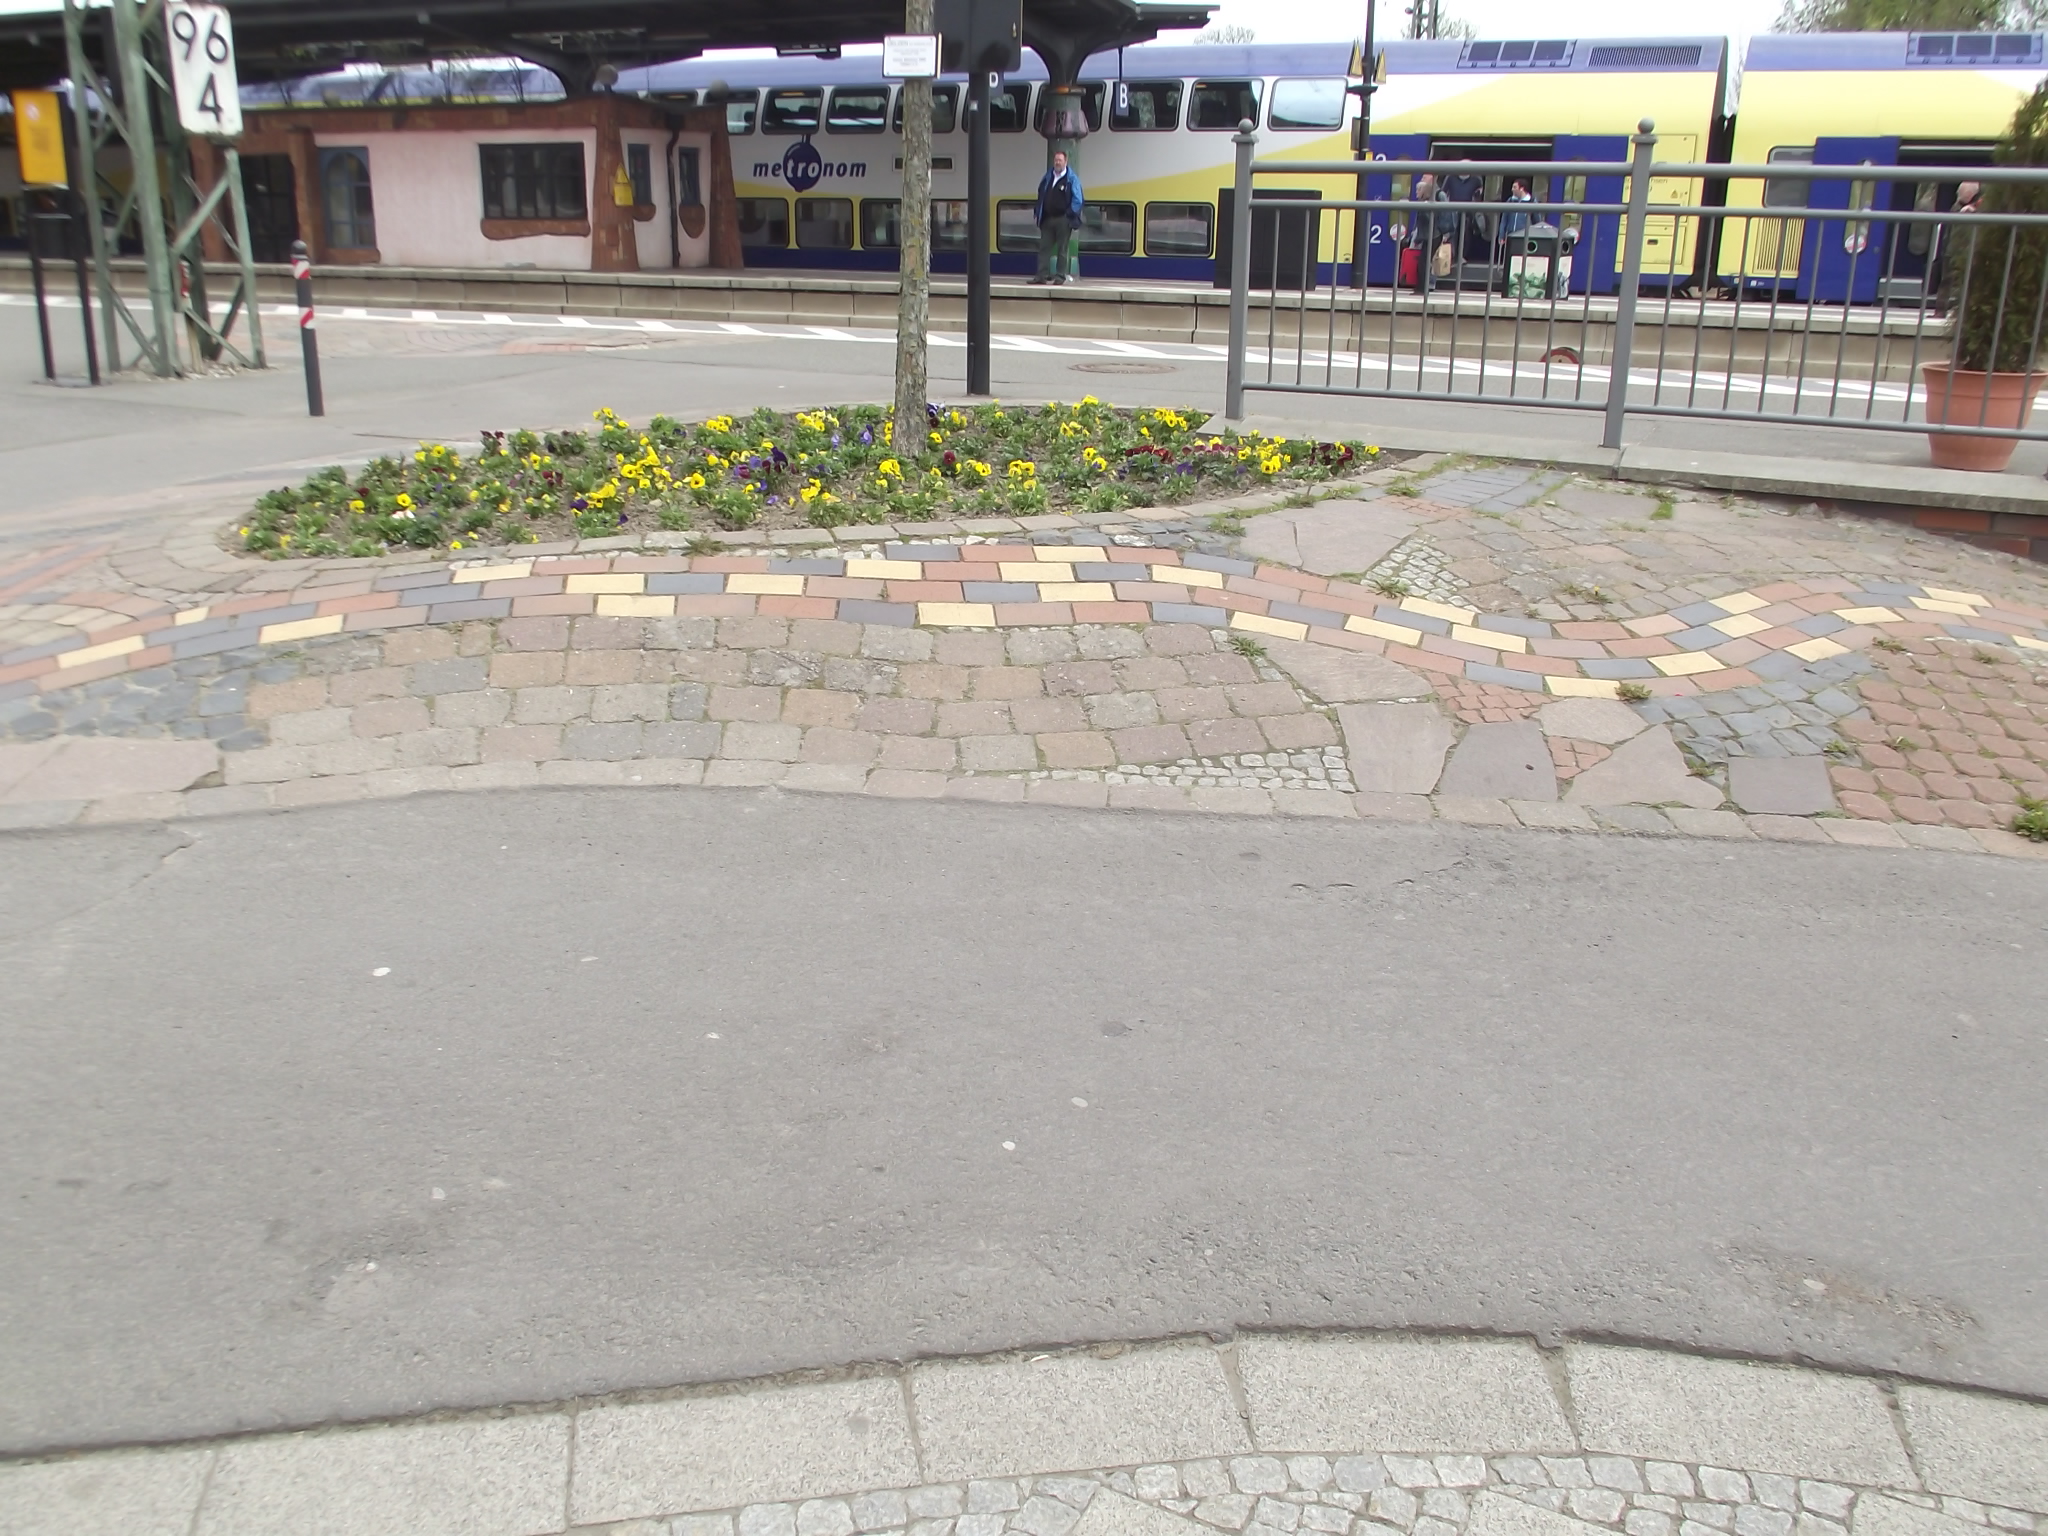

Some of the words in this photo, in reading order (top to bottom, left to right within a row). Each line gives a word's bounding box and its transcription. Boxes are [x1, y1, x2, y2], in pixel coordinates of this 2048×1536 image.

[172, 11, 228, 64] 96
[989, 71, 999, 88] D
[198, 72, 223, 124] 4
[1120, 83, 1128, 109] B
[753, 158, 867, 178] metronom
[1369, 224, 1382, 244] 2
